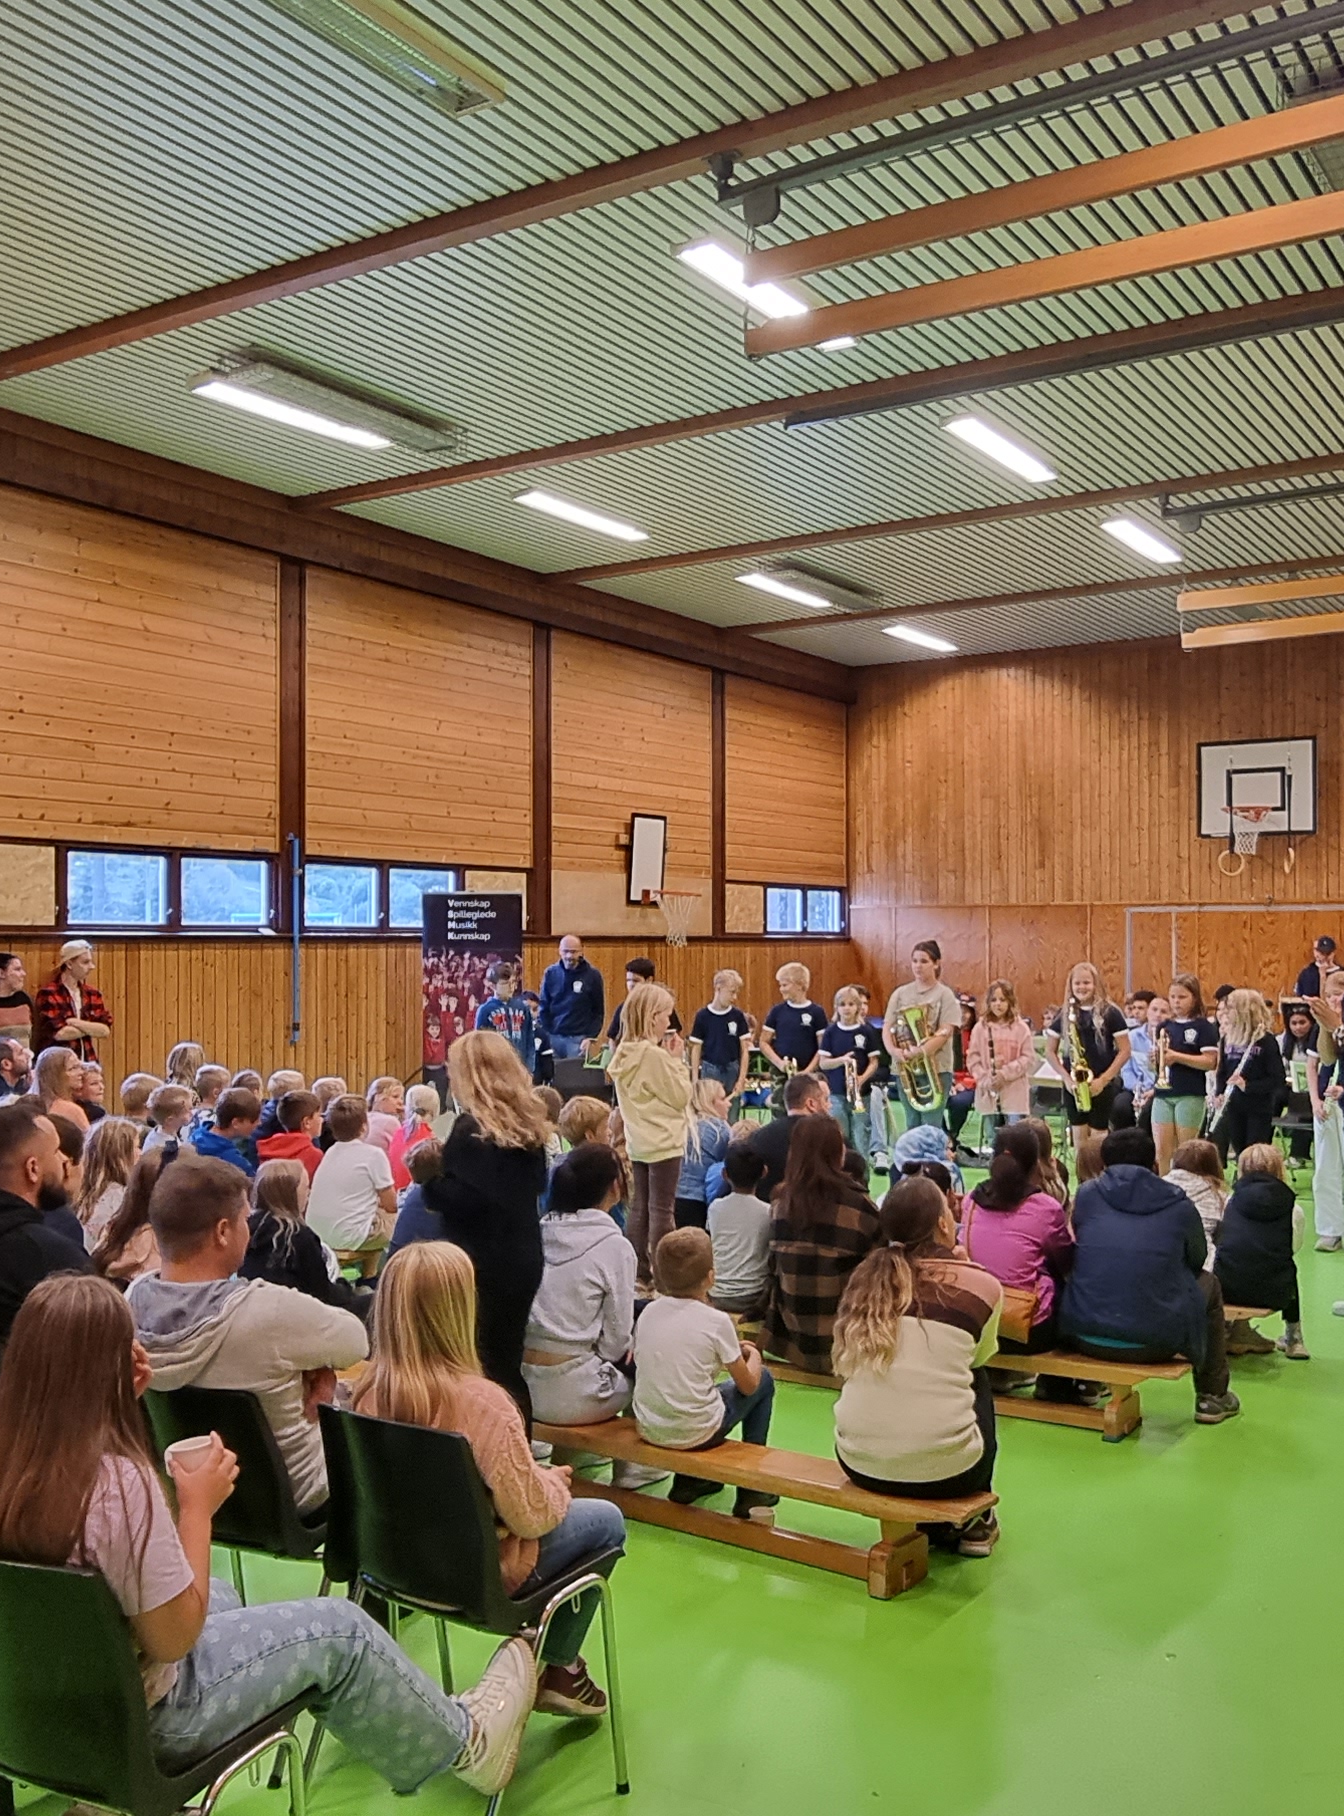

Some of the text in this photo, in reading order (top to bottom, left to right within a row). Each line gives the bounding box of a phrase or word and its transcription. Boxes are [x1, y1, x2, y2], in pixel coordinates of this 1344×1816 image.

[448, 899, 491, 908] Vennskap
[447, 910, 497, 920] Spilleglede
[447, 921, 477, 929] Musikk
[447, 932, 491, 941] Kunnskap
